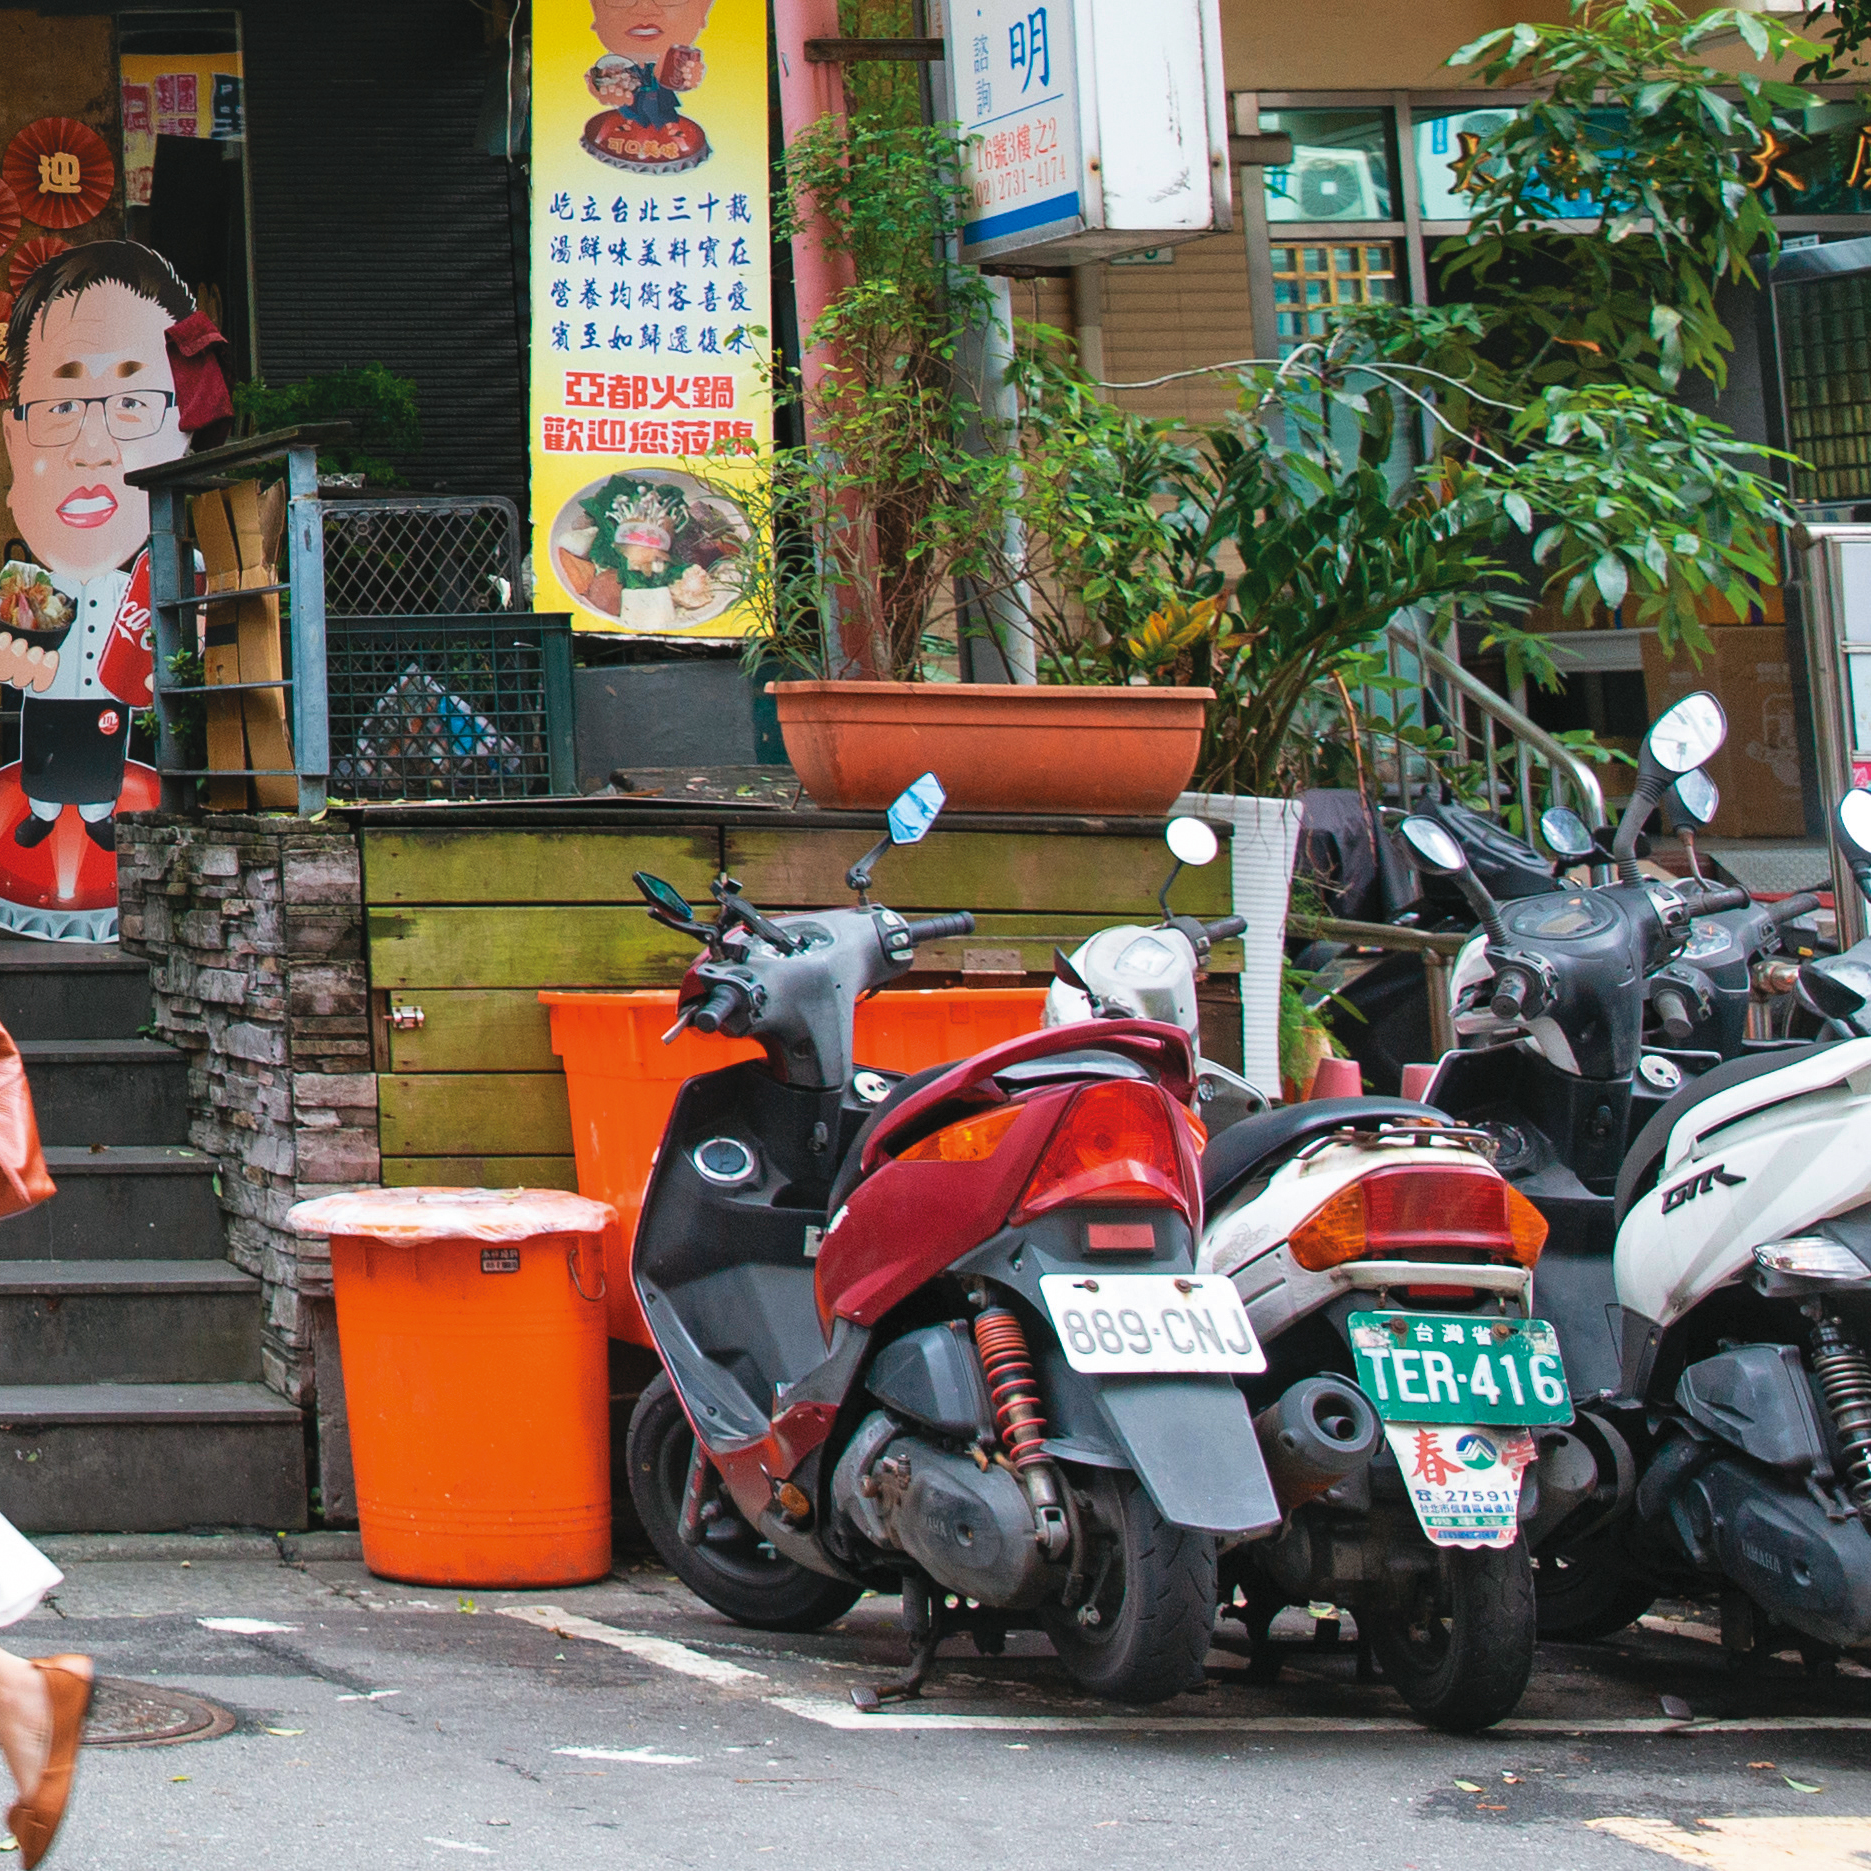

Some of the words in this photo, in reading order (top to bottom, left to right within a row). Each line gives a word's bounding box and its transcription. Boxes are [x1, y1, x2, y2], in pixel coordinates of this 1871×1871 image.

[975, 117, 1059, 173] 16號3樓之2
[38, 151, 82, 194] 迎
[550, 234, 752, 268] 湯鮮味美料實在
[550, 276, 753, 312] 營養均衡客喜愛
[565, 371, 735, 410] 亞都火鍋
[1413, 1322, 1493, 1347] 台灣省
